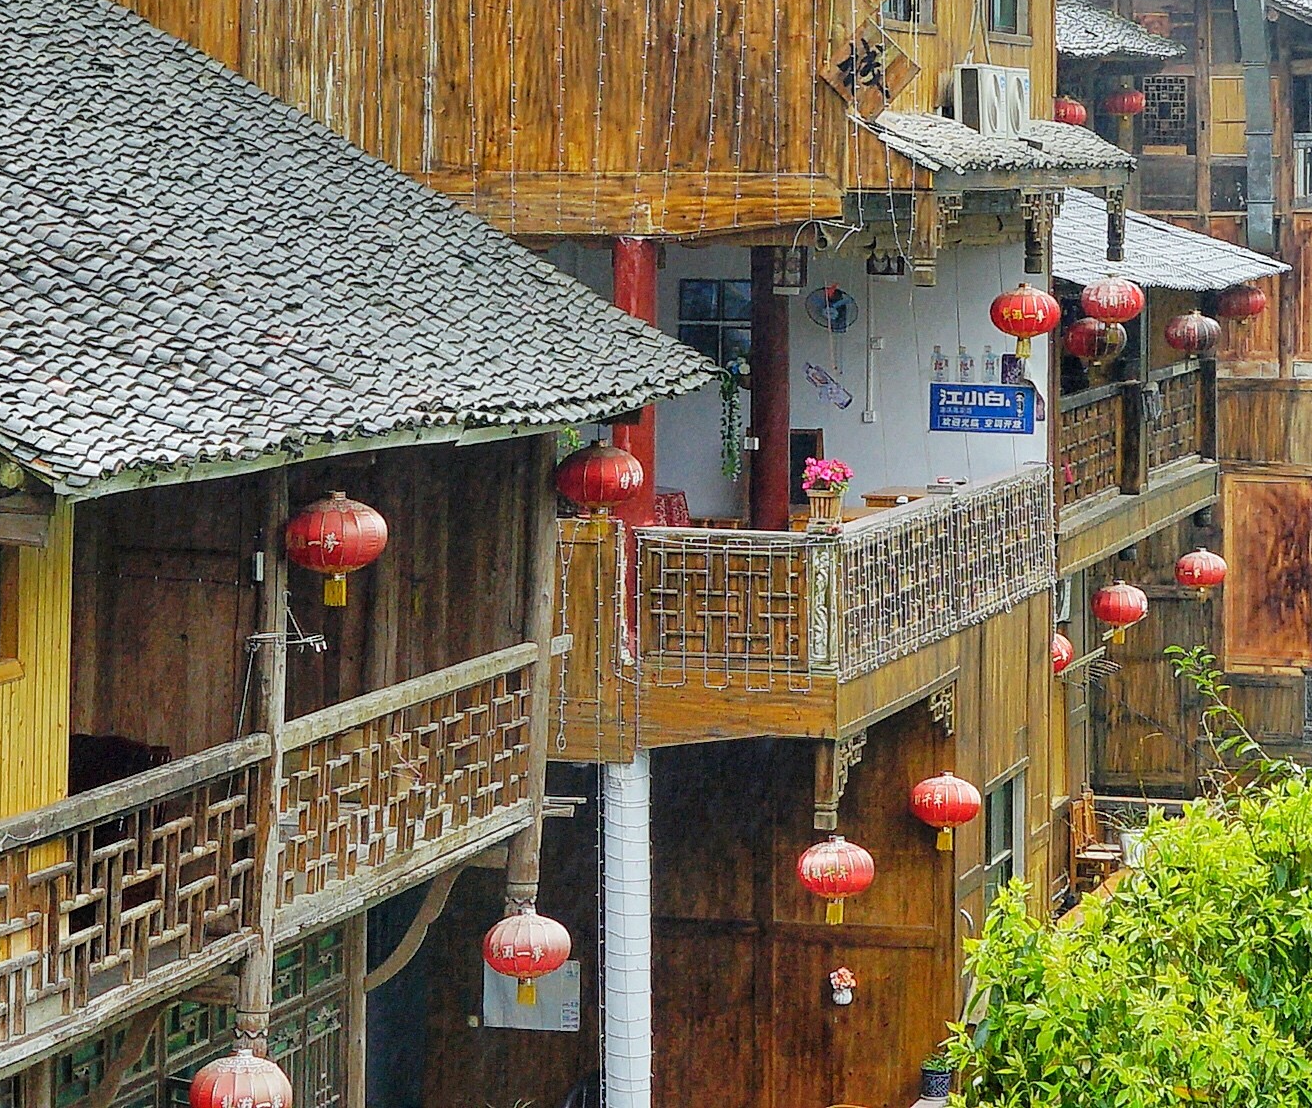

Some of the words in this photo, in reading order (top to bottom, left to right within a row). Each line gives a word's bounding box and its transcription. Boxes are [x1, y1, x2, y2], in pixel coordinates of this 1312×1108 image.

[939, 388, 1005, 407] 江小白
[941, 417, 980, 429] 欢迎光临
[984, 418, 1023, 430] 空调开放
